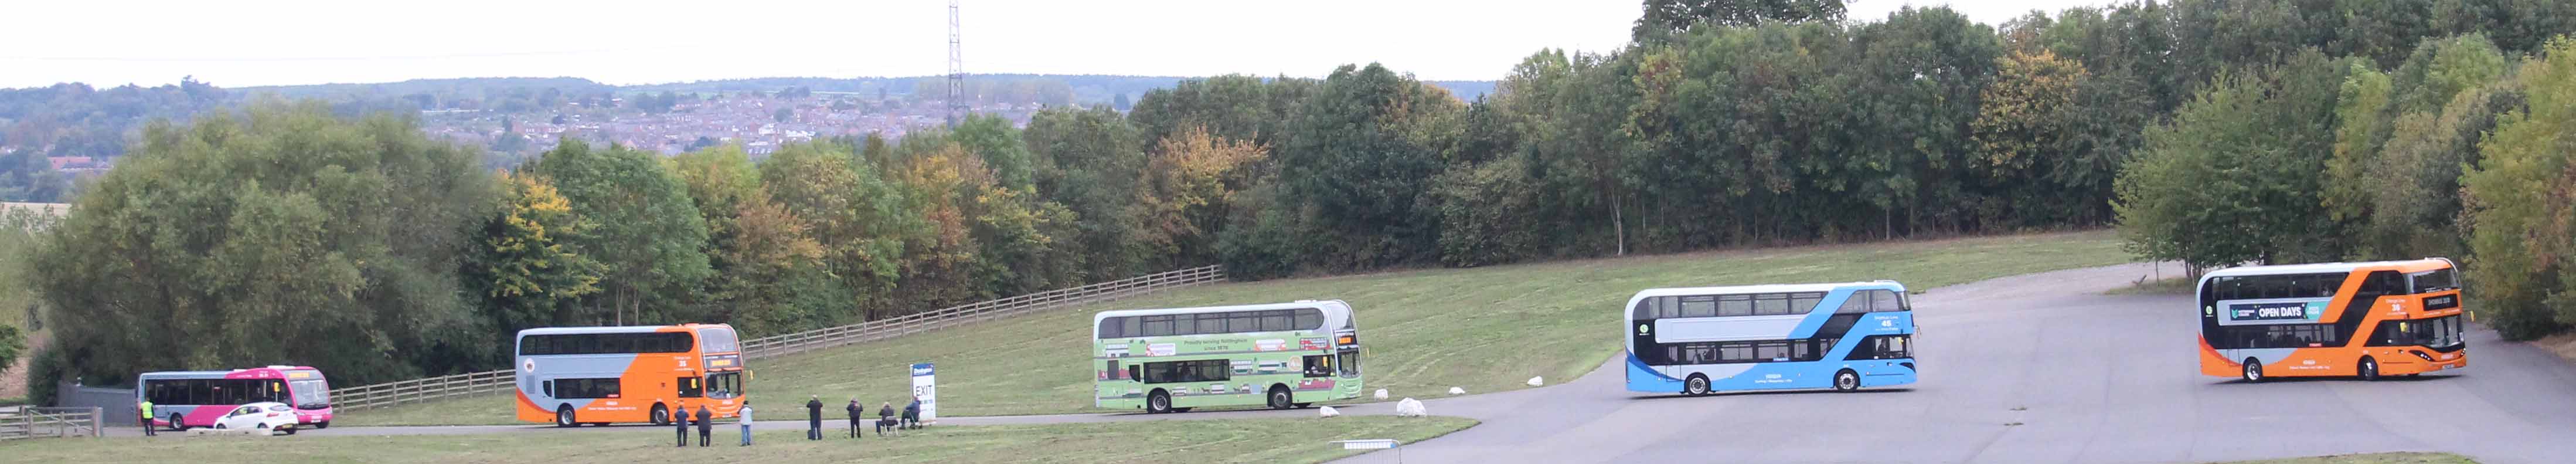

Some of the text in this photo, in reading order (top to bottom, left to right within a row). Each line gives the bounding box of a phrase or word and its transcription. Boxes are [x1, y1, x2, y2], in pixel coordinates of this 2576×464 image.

[2258, 307, 2280, 318] OPEN
[2281, 306, 2302, 317] DAYS
[916, 384, 933, 396] EXIT
